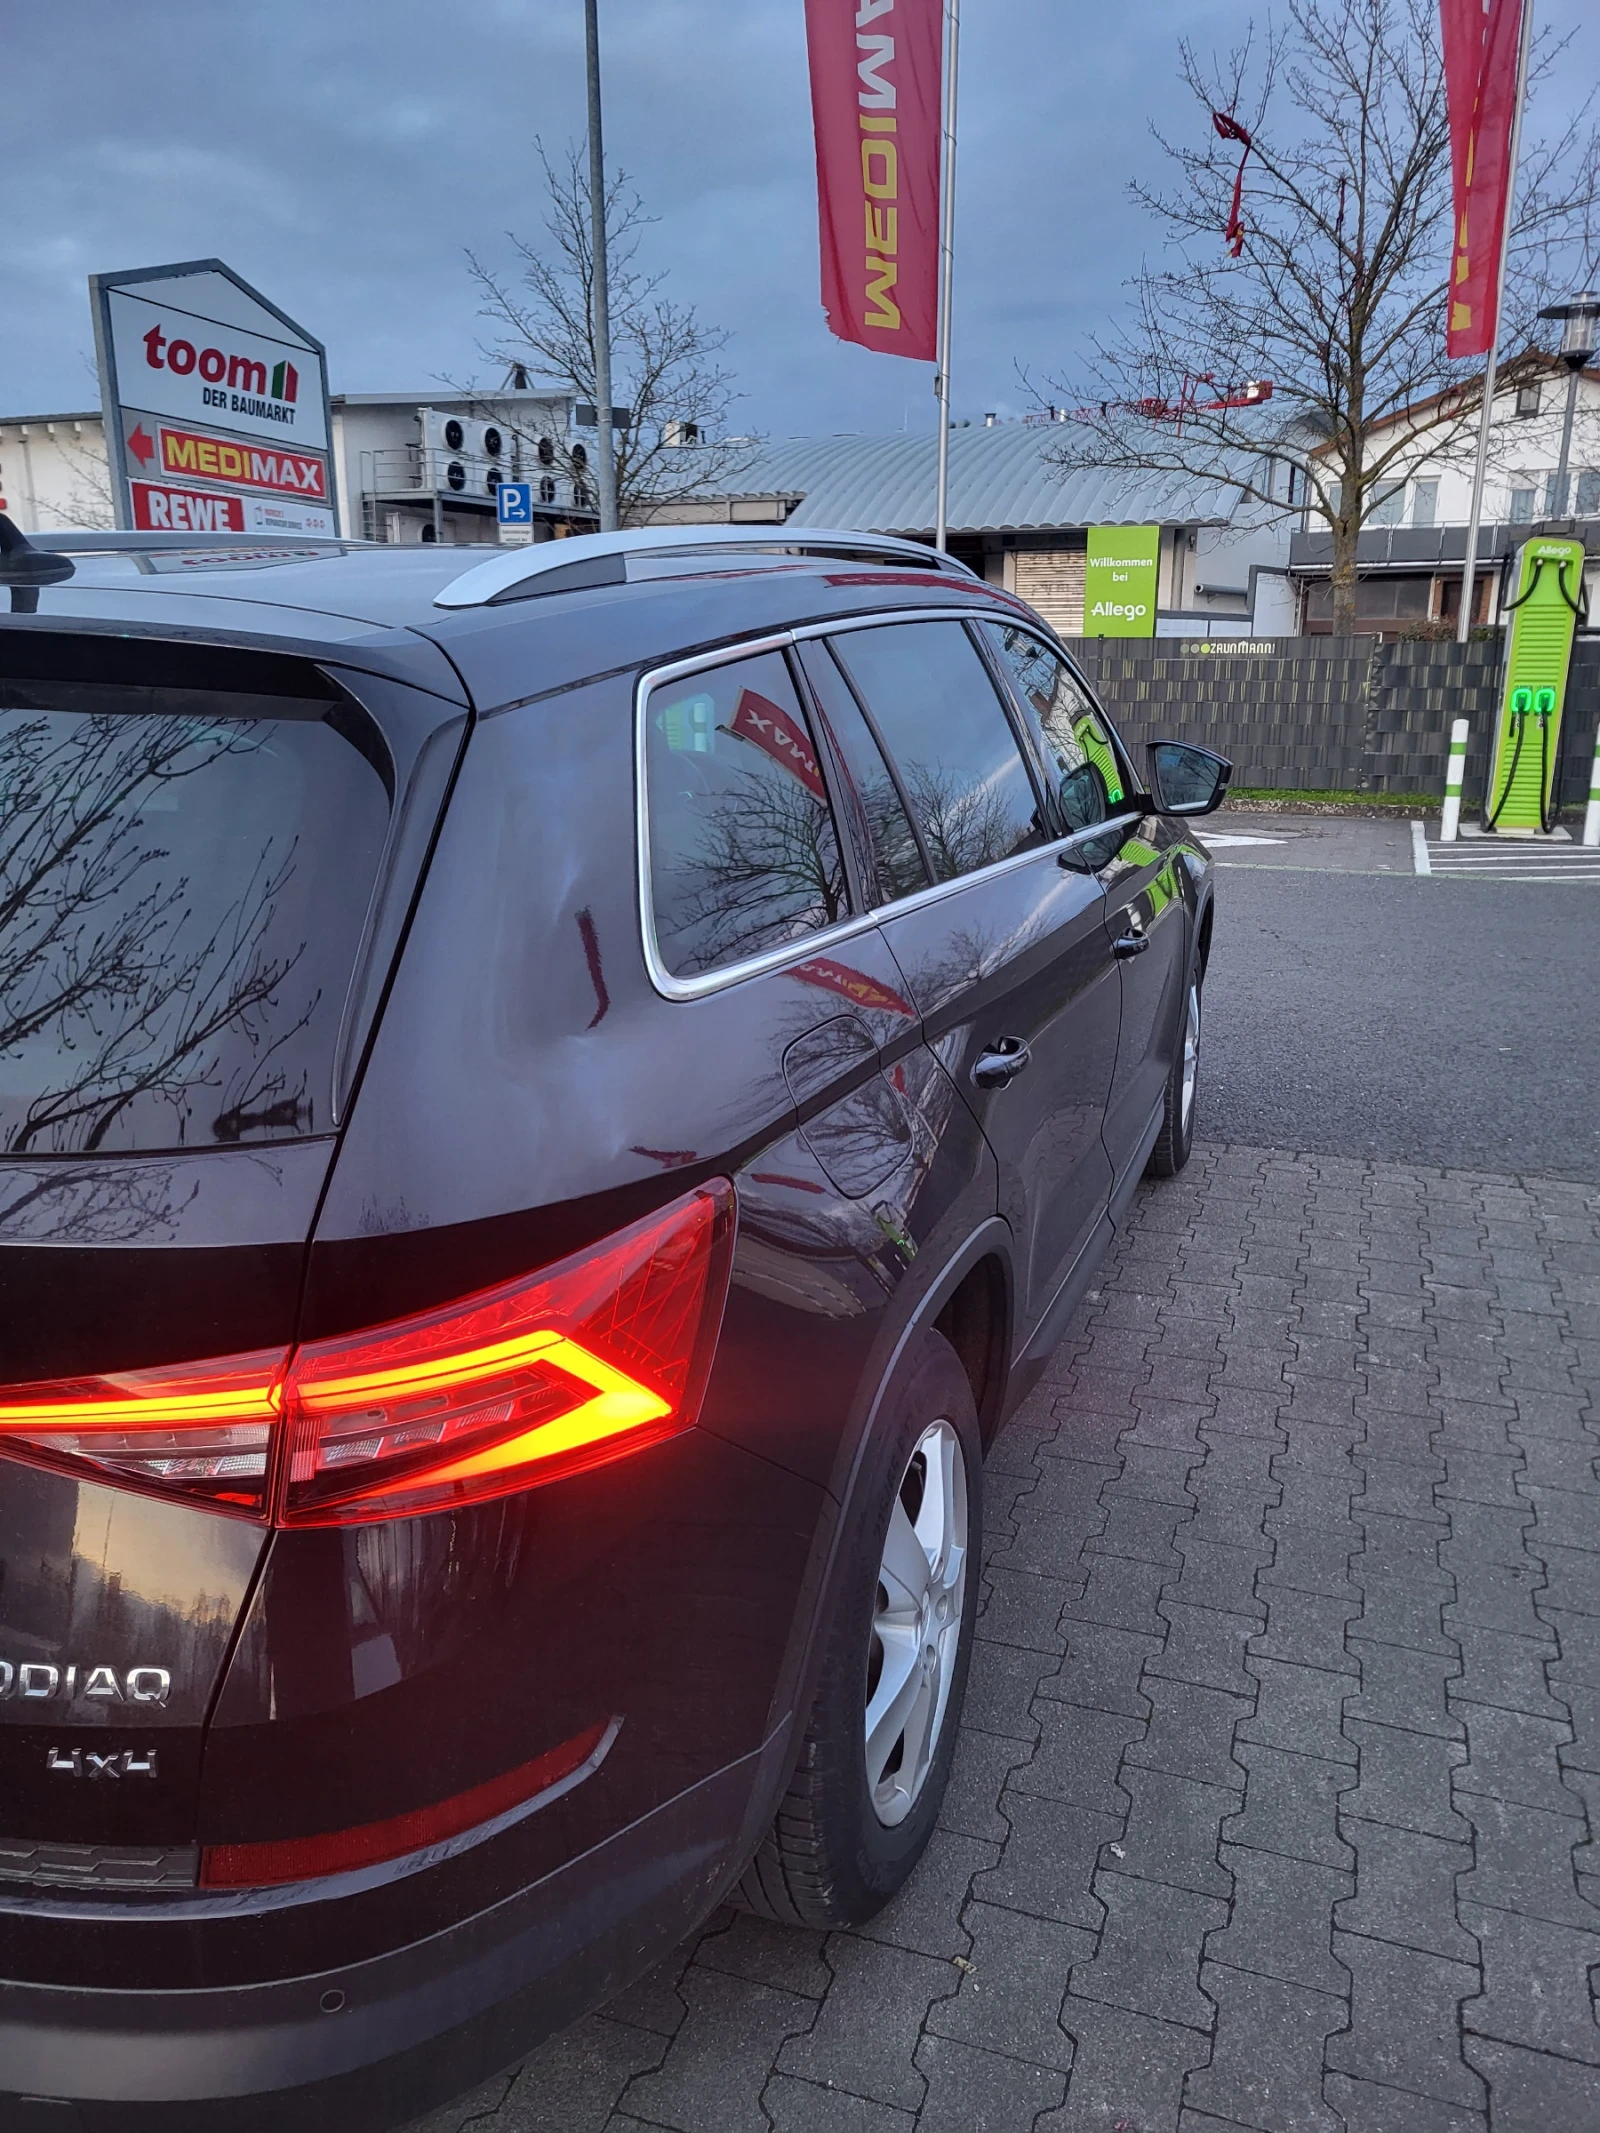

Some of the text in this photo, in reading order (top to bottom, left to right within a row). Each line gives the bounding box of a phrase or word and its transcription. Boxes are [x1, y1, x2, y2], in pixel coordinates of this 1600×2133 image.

[143, 323, 268, 395] toom
[203, 387, 296, 425] DER BAUMARKT
[166, 435, 322, 492] MEDIMAX
[147, 490, 229, 532] REWE
[502, 488, 522, 519] P
[1090, 557, 1153, 568] Willkommen
[1537, 545, 1572, 557] Allego
[1112, 572, 1128, 582] bei
[1090, 601, 1146, 621] Allego
[47, 1747, 158, 1779] 4x4
